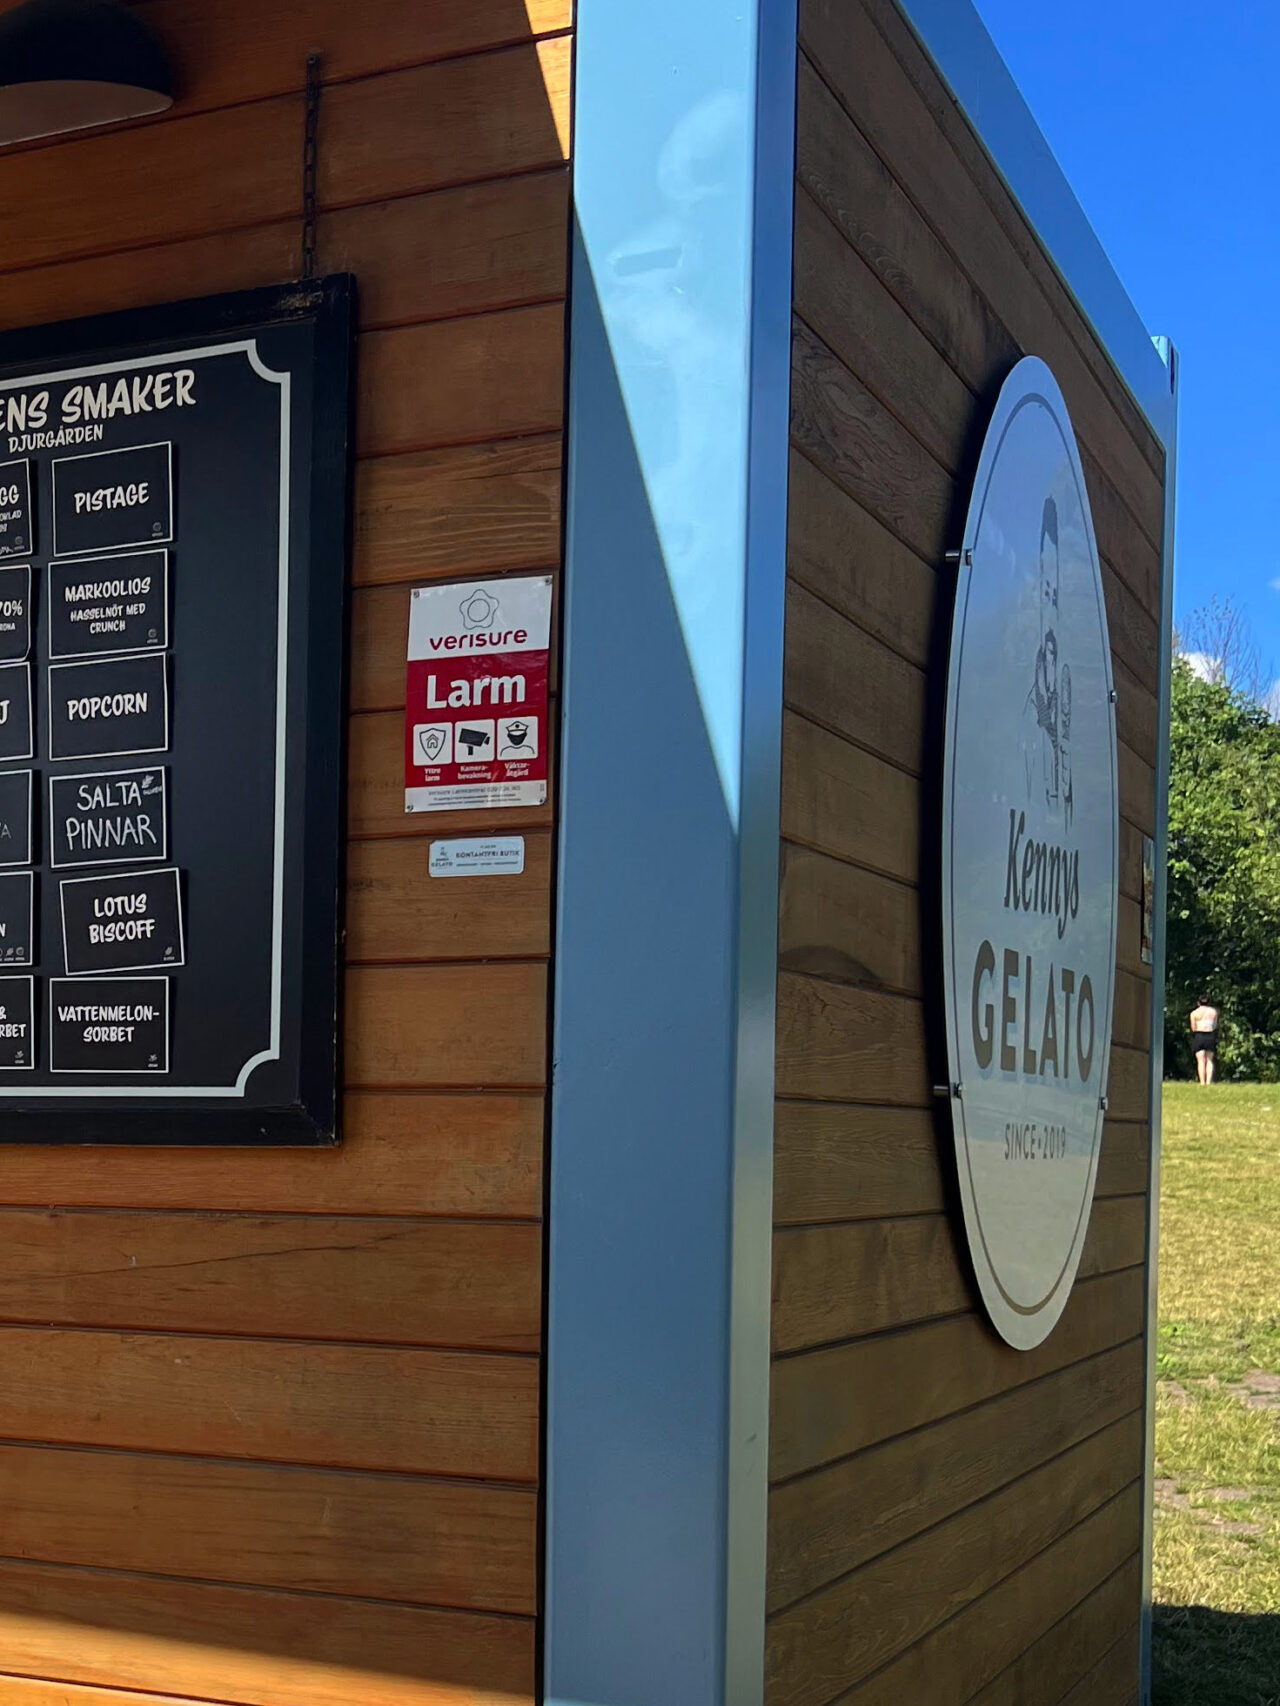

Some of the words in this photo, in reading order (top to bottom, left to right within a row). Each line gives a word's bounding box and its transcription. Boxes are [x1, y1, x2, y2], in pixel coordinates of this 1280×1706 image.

[61, 369, 197, 423] SMAKER
[8, 424, 104, 454] DJURGÅRDEN
[74, 482, 149, 514] PISTAGE
[65, 576, 151, 602] MARKOOLIOS
[70, 604, 124, 622] HASSELNÖT
[126, 602, 146, 616] MED
[89, 620, 126, 634] CRUNCH
[429, 629, 528, 651] verisure
[426, 673, 526, 710] Larm
[67, 692, 148, 721] POPCORN
[77, 781, 142, 811] SALTA
[1004, 808, 1080, 940] Kennys
[94, 893, 147, 918] LOTUS
[89, 919, 156, 944] BISCOFF
[58, 1005, 160, 1022] VATTENMELON-
[972, 939, 1095, 1083] GELATO
[83, 1026, 135, 1042] SORBET
